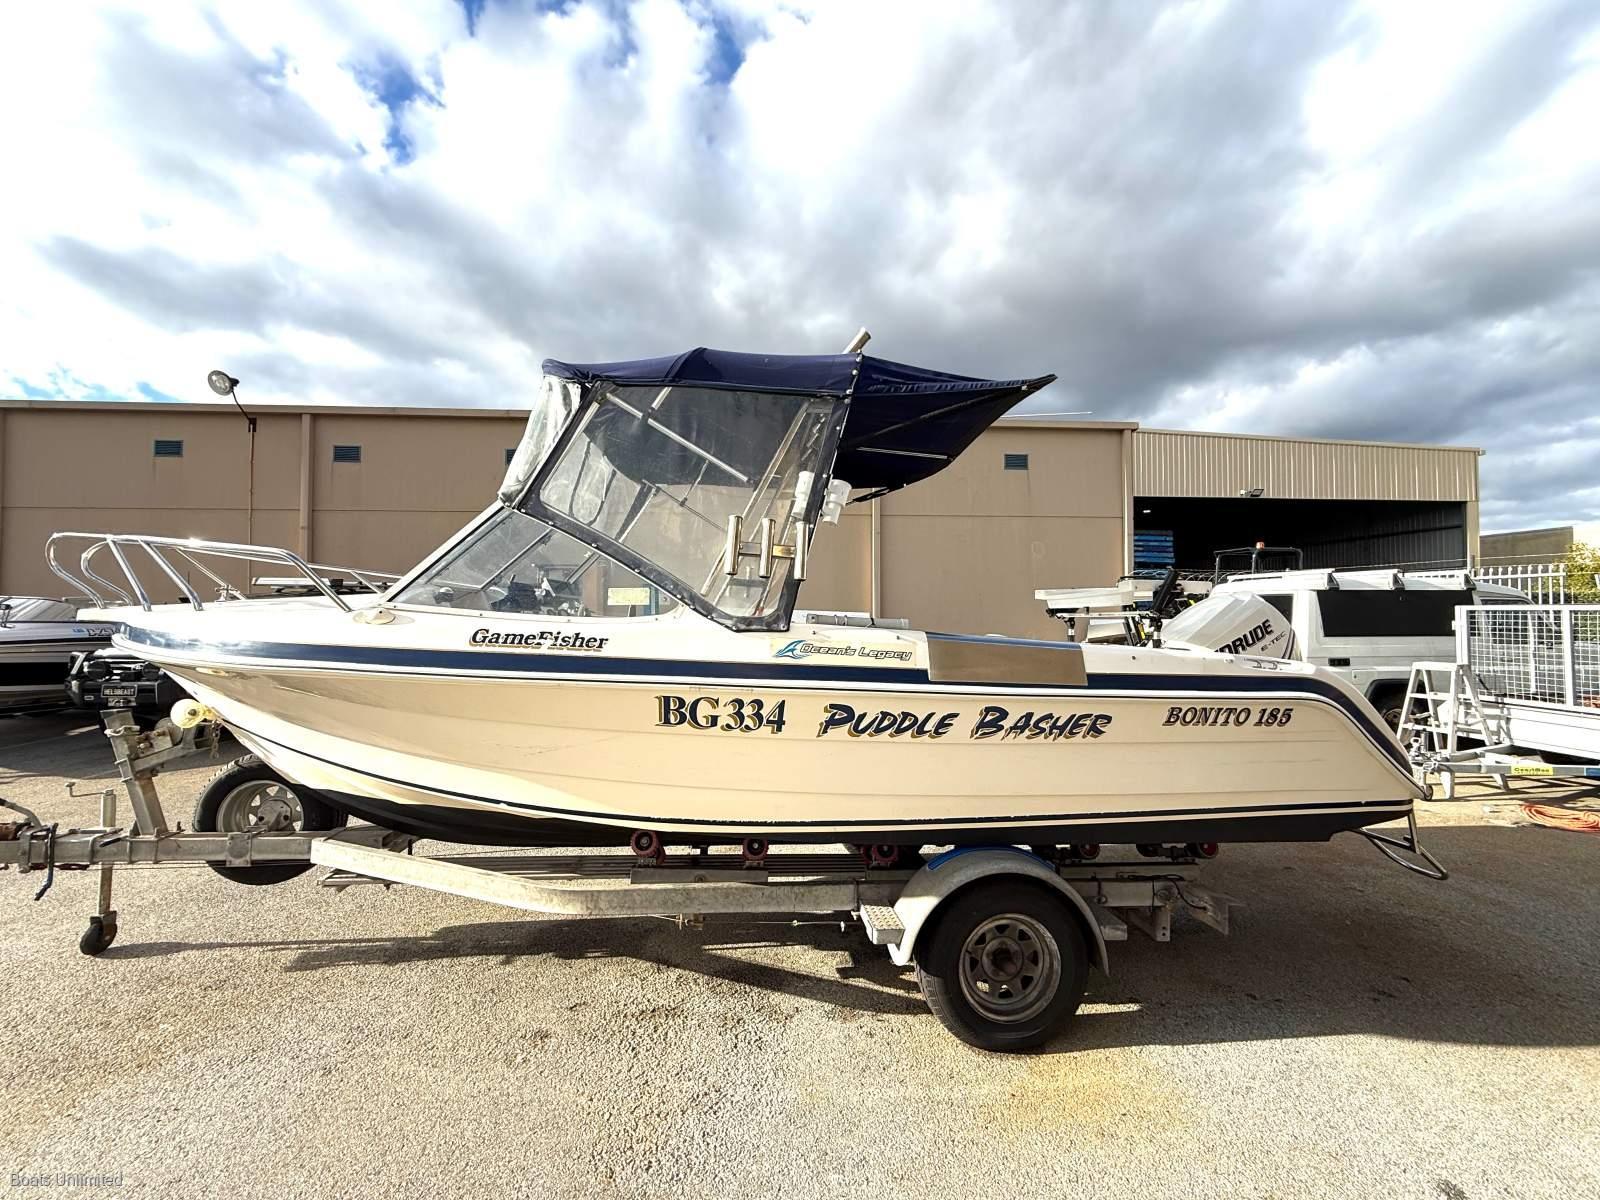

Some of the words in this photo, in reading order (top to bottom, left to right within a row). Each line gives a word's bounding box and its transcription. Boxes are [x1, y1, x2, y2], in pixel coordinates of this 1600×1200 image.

[469, 628, 609, 652] GameFisher
[800, 642, 857, 656] Ocean's
[858, 646, 912, 661] Legacy
[816, 703, 960, 740] PUDDLE
[970, 706, 1113, 741] BASHER
[1162, 706, 1252, 727] BONITO
[1253, 707, 1294, 727] 185
